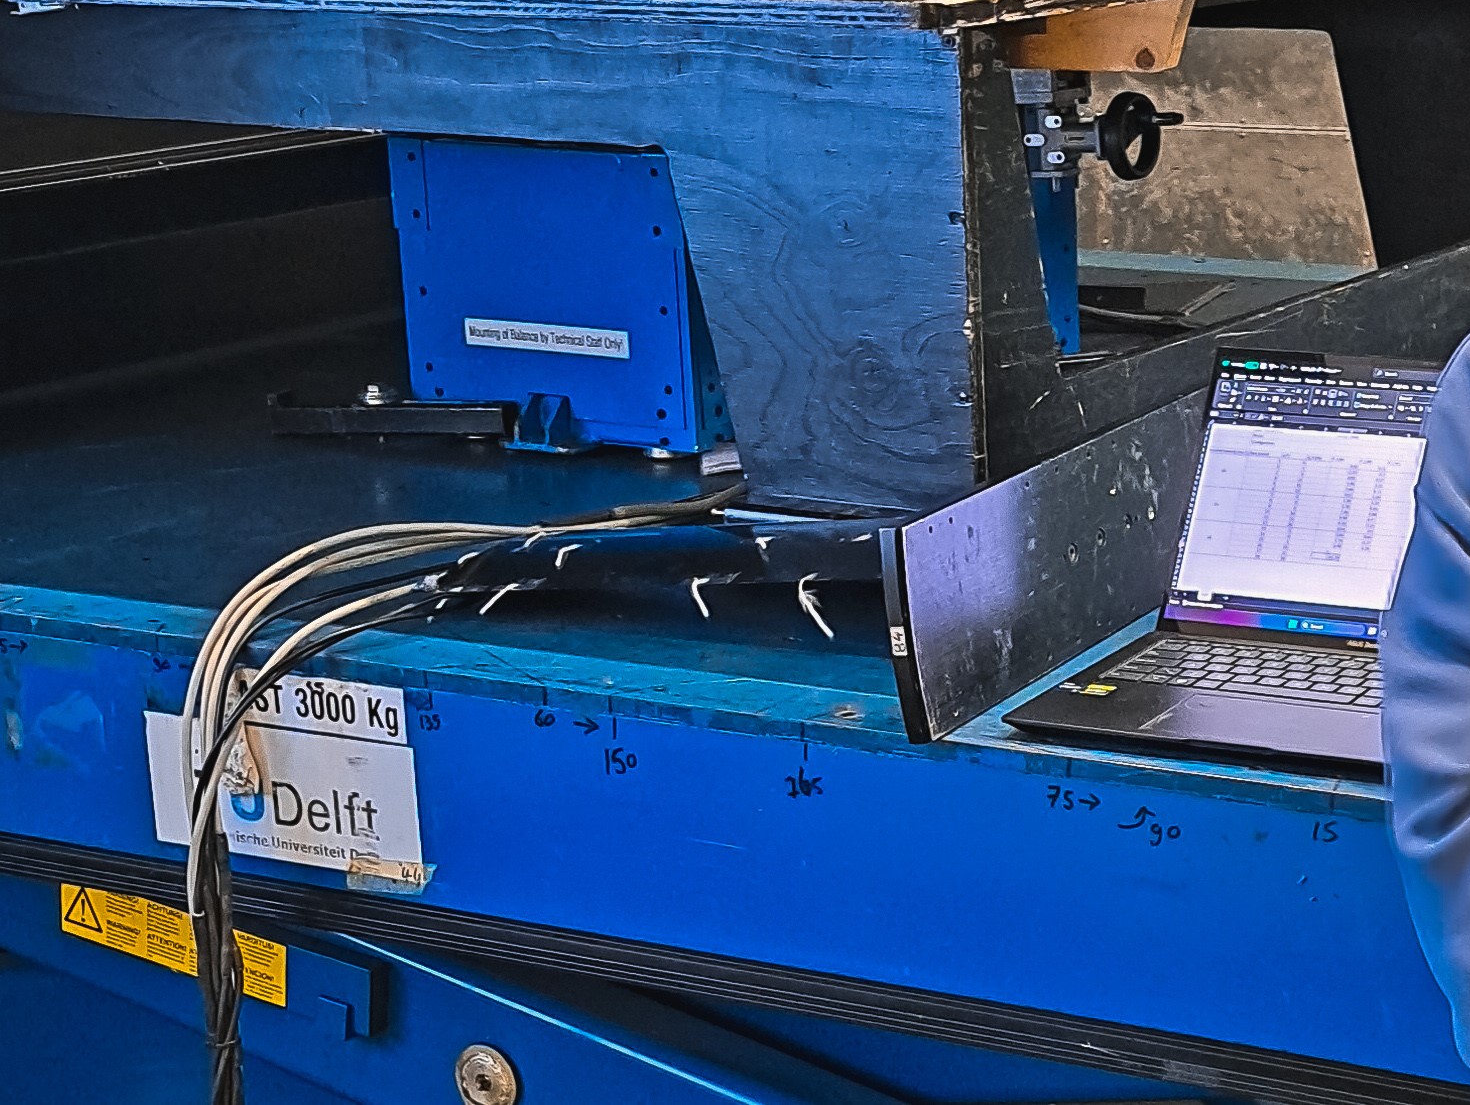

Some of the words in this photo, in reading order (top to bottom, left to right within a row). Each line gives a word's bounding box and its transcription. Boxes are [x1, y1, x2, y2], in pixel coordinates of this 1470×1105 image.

[468, 325, 501, 341] Mounting
[510, 328, 539, 343] Balance
[540, 330, 549, 345] by
[550, 331, 585, 347] Technical
[295, 687, 356, 725] 3000
[367, 697, 399, 736] Kg
[604, 747, 637, 775] 150
[271, 780, 379, 836] Delft
[1046, 784, 1075, 810] 75
[271, 836, 346, 860] Universiteit
